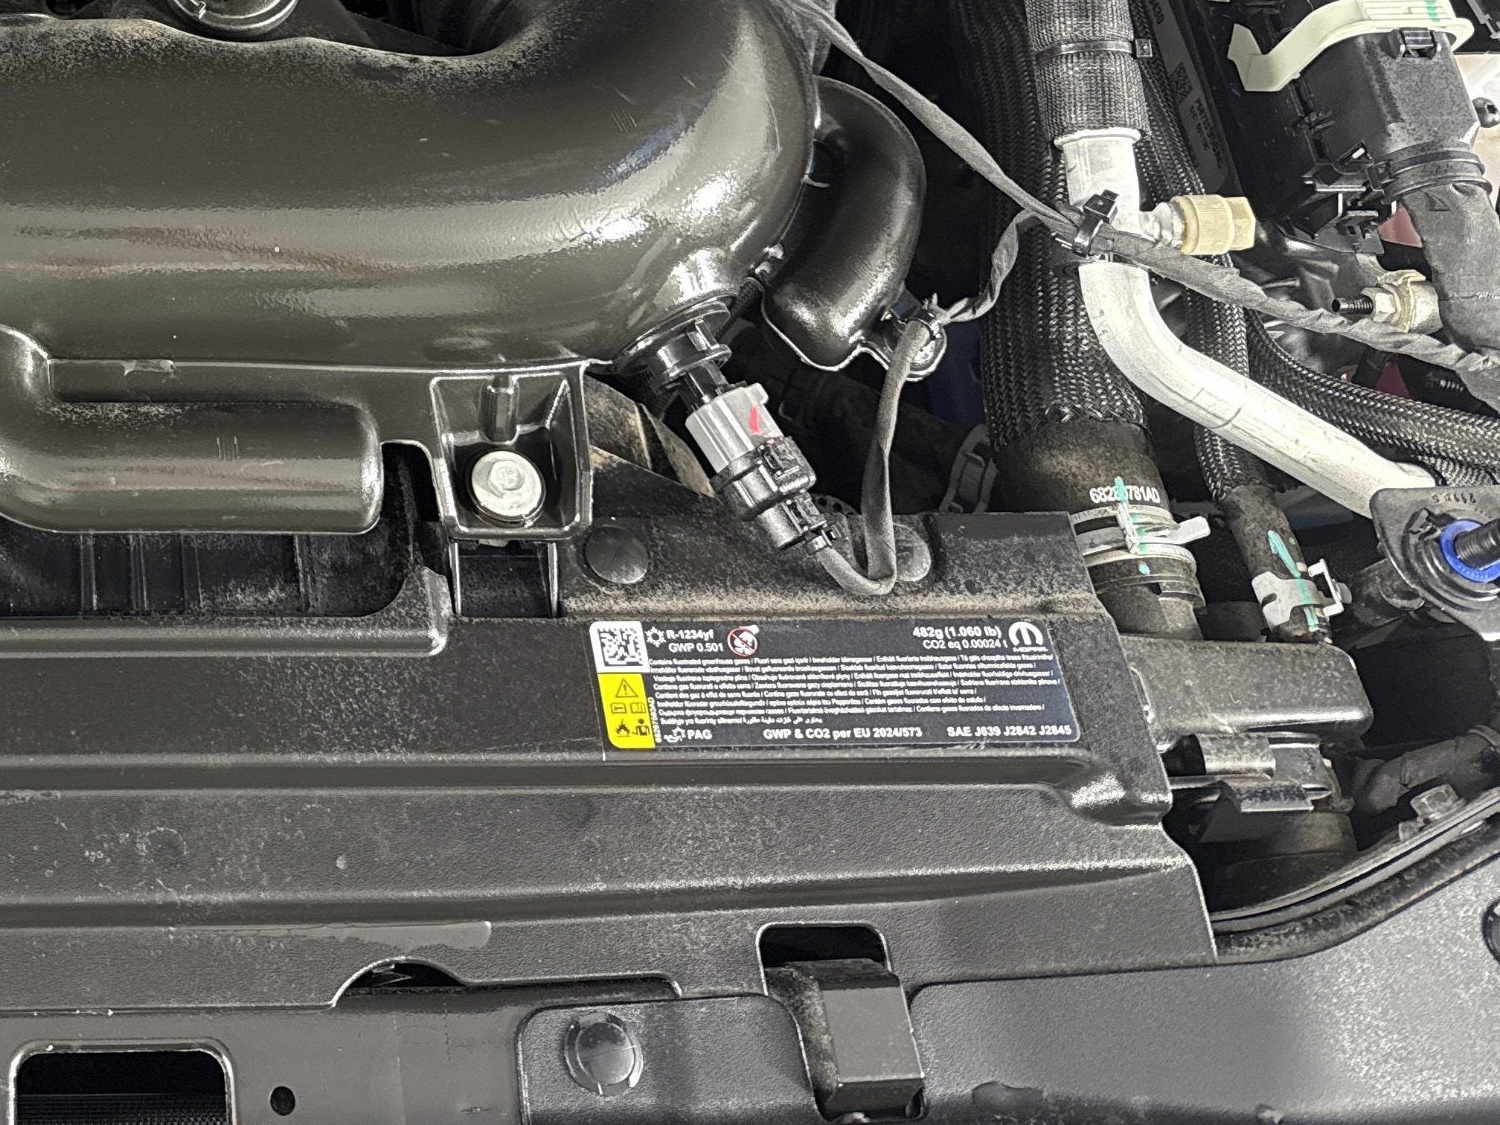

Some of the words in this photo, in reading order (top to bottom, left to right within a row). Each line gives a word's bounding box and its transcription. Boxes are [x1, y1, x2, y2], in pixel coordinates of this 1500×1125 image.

[1089, 485, 1161, 504] 6828781AD
[665, 629, 714, 641] R-1234yf
[912, 626, 943, 639] 482g
[944, 626, 982, 639] (1.060
[984, 626, 1002, 639] lb)
[668, 642, 695, 653] GWP
[696, 642, 724, 653] 0.501
[922, 639, 946, 649] CO2
[947, 640, 962, 651] eq
[962, 638, 1001, 649] 0.00024
[687, 729, 713, 740] PAG
[763, 729, 792, 739] GWP
[794, 728, 804, 739] &
[805, 728, 831, 739] CO2
[832, 729, 852, 741] per
[853, 728, 871, 738] EU
[872, 727, 923, 738] 2024/573
[947, 726, 972, 737] SAE
[975, 726, 1001, 737] J639
[1003, 725, 1036, 736] J2842
[1039, 725, 1072, 736] J2845
